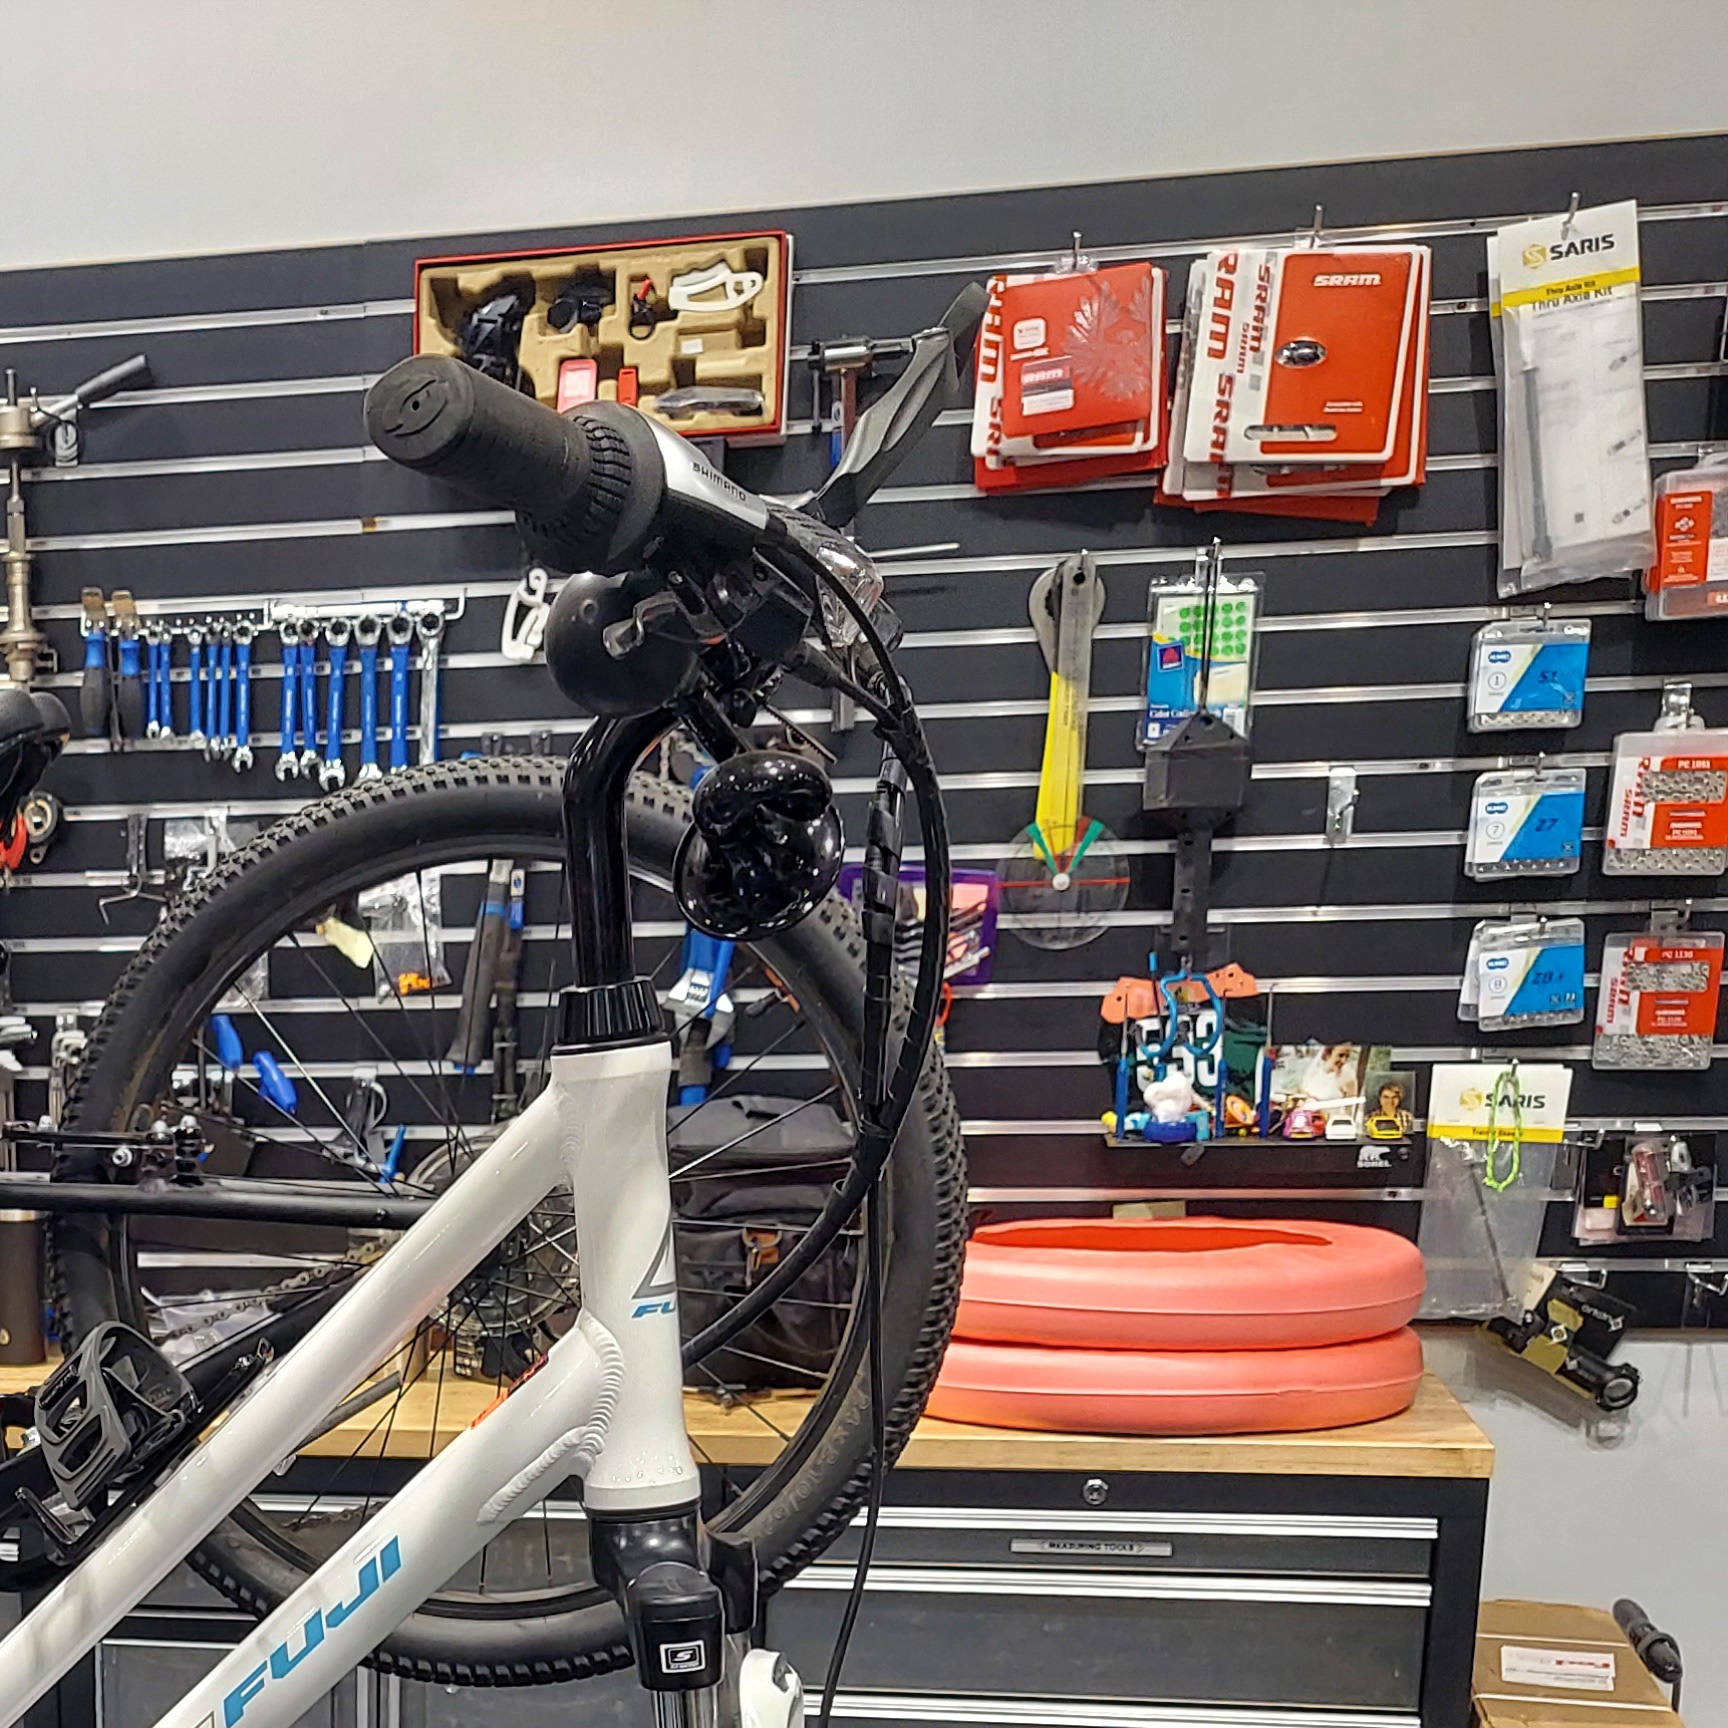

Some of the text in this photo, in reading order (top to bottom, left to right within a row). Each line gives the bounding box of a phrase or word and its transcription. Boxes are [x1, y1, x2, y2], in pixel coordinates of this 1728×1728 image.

[1549, 233, 1615, 261] SARIS
[1313, 273, 1383, 288] SRAM
[692, 461, 747, 502] SHIMANO
[1485, 1093, 1546, 1110] SARIS
